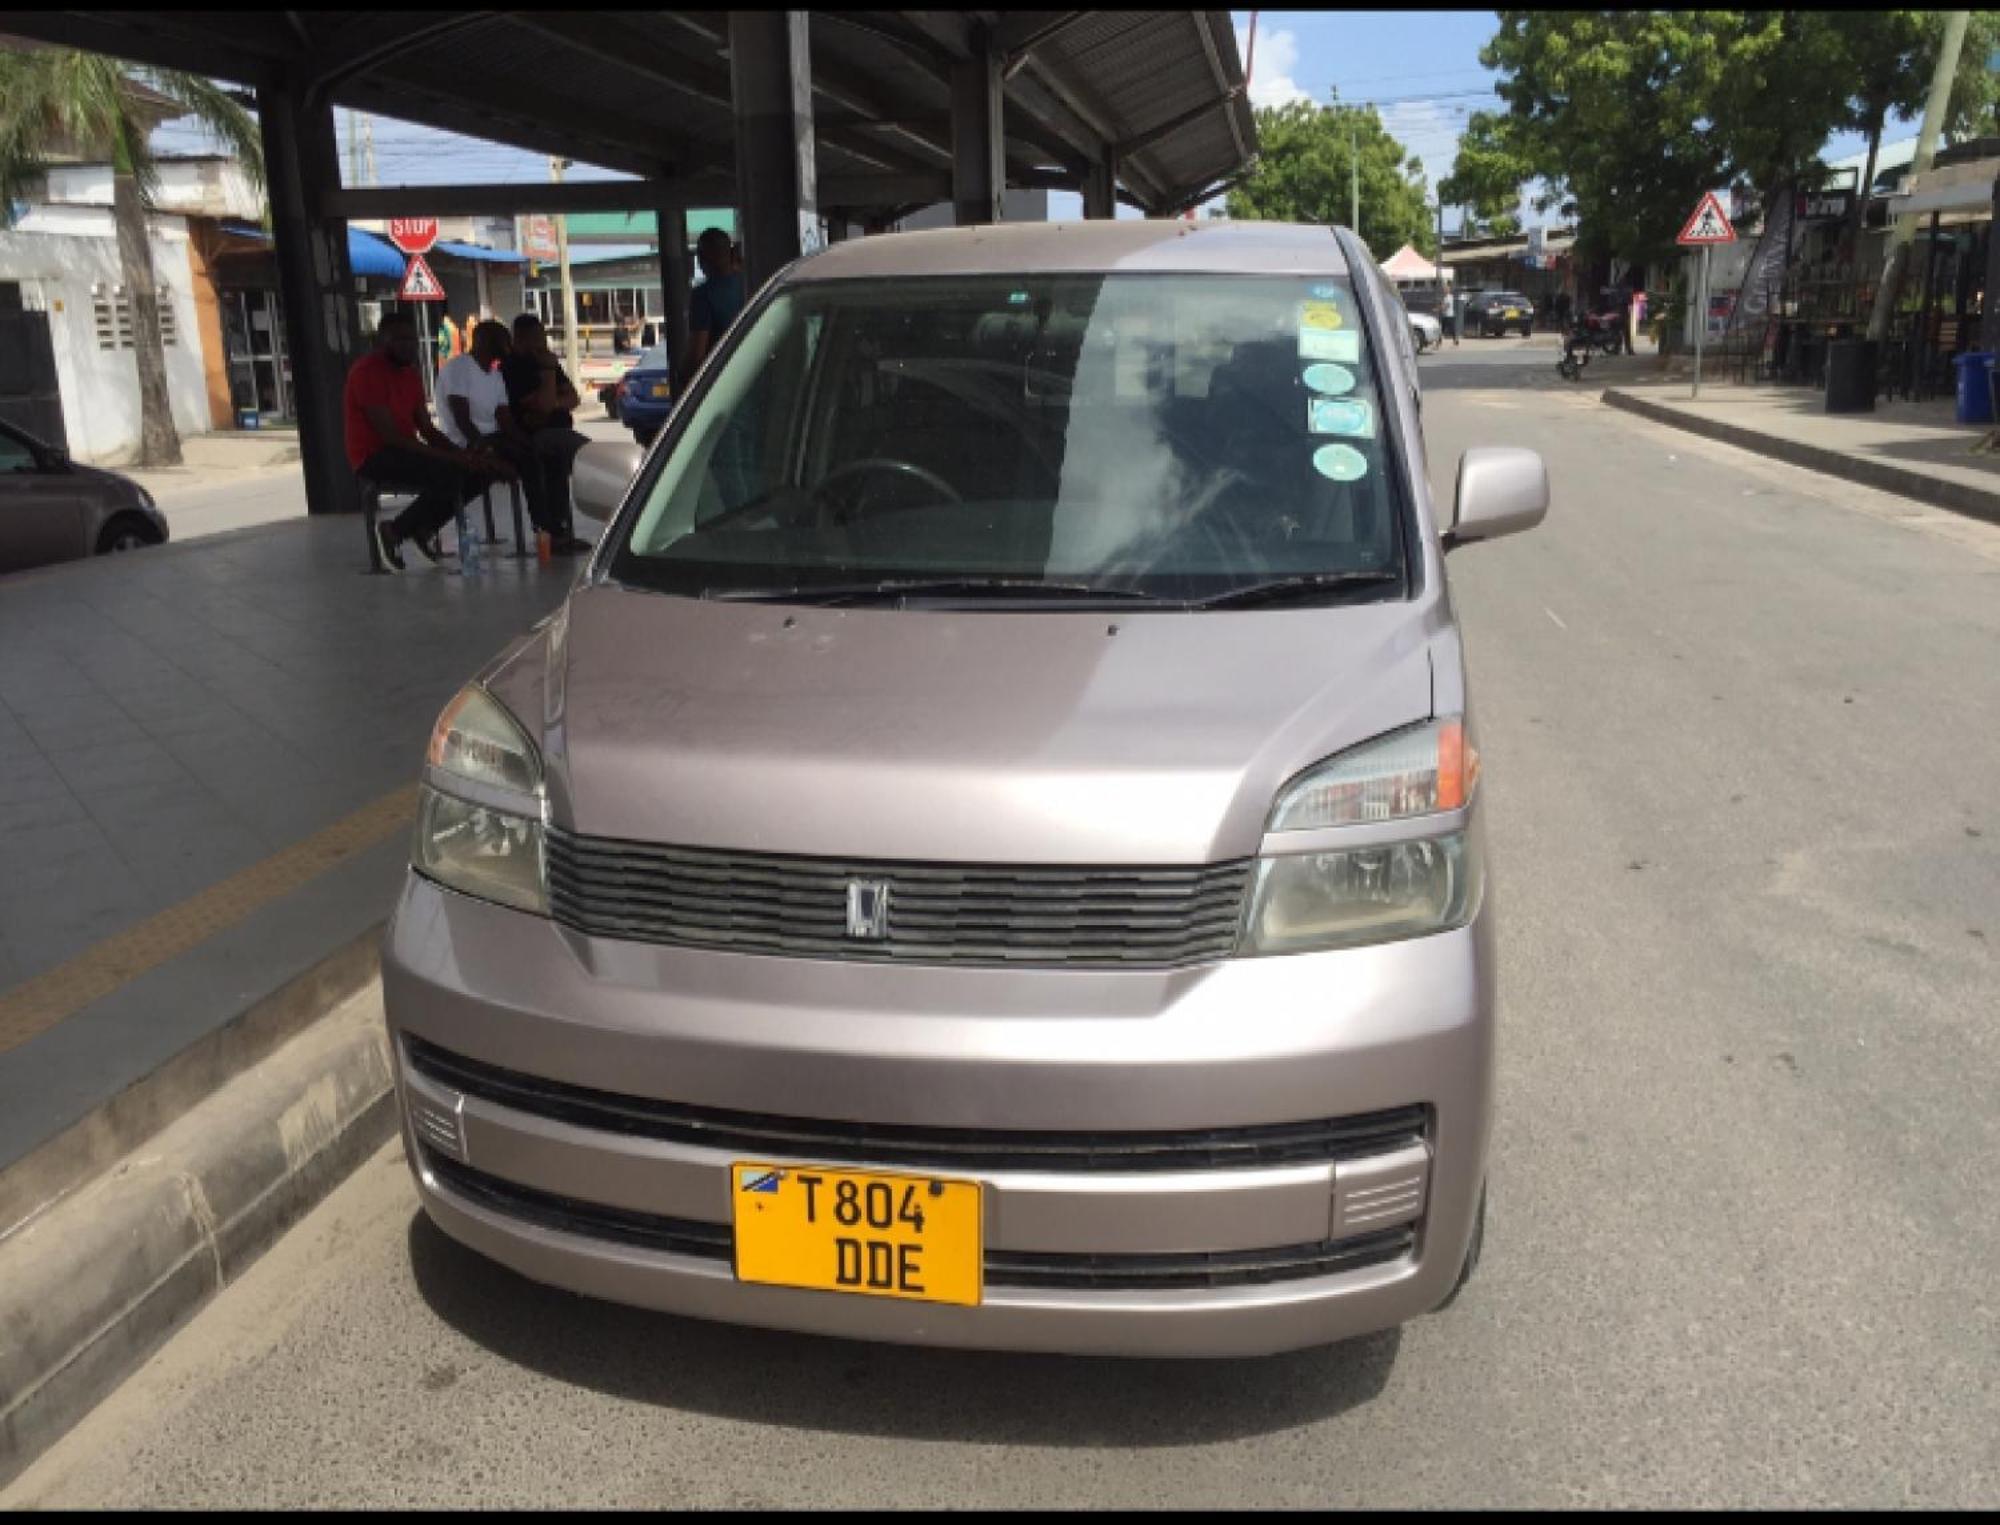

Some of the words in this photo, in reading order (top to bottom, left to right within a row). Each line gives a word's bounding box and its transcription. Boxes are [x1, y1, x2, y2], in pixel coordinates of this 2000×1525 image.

[393, 218, 434, 235] STOP
[797, 1175, 823, 1223] T
[834, 1179, 925, 1233] 804
[835, 1237, 925, 1292] DDE
